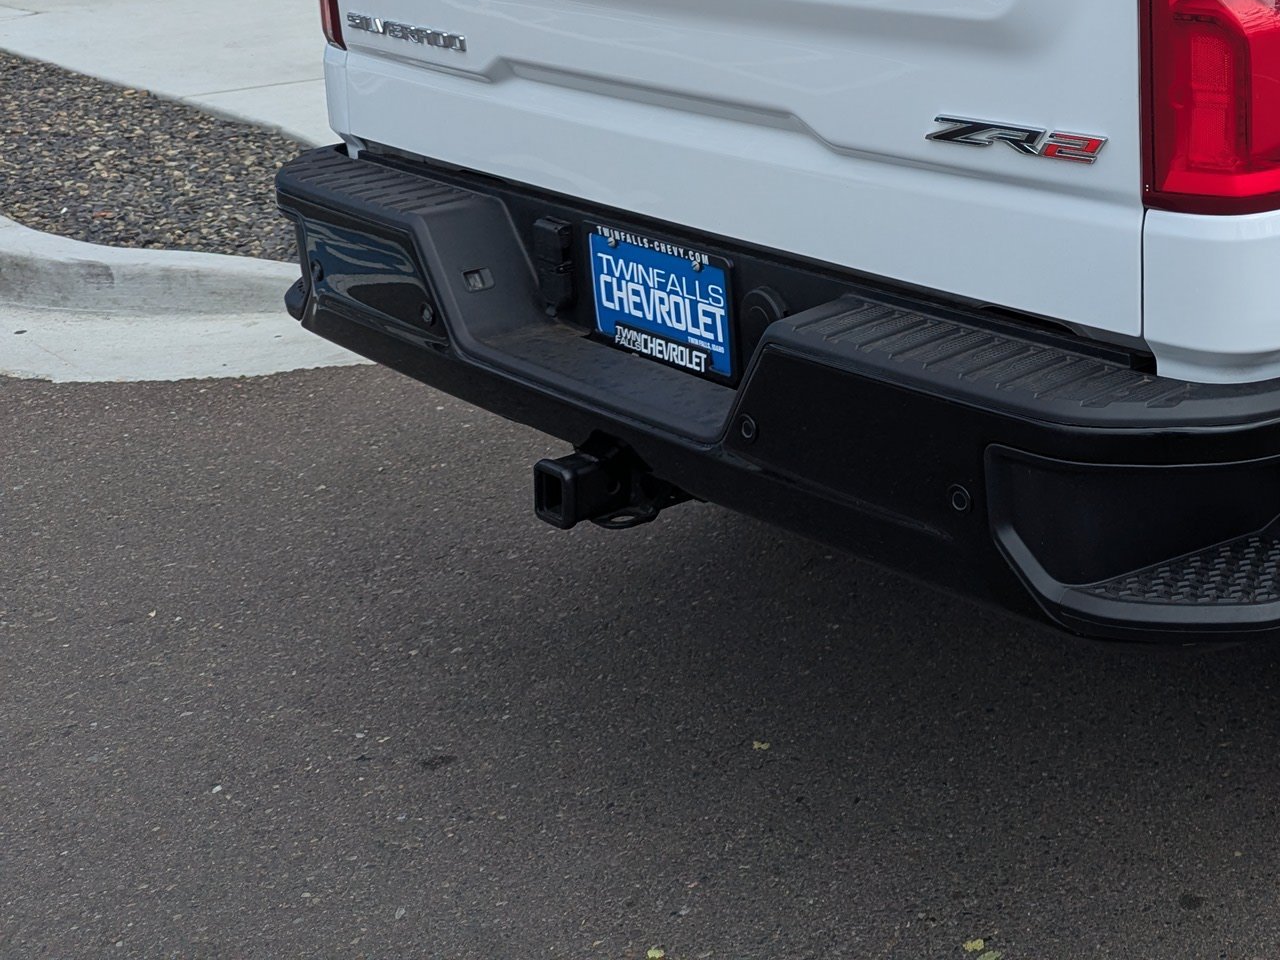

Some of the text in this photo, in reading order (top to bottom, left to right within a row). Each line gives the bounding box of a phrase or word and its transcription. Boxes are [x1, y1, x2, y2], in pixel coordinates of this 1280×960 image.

[347, 12, 467, 52] SILVERADO
[925, 114, 1109, 165] ZR2
[600, 274, 725, 343] CHEVROLET
[615, 336, 642, 352] FALLS
[615, 325, 707, 373] TWIN CHEVROLET
